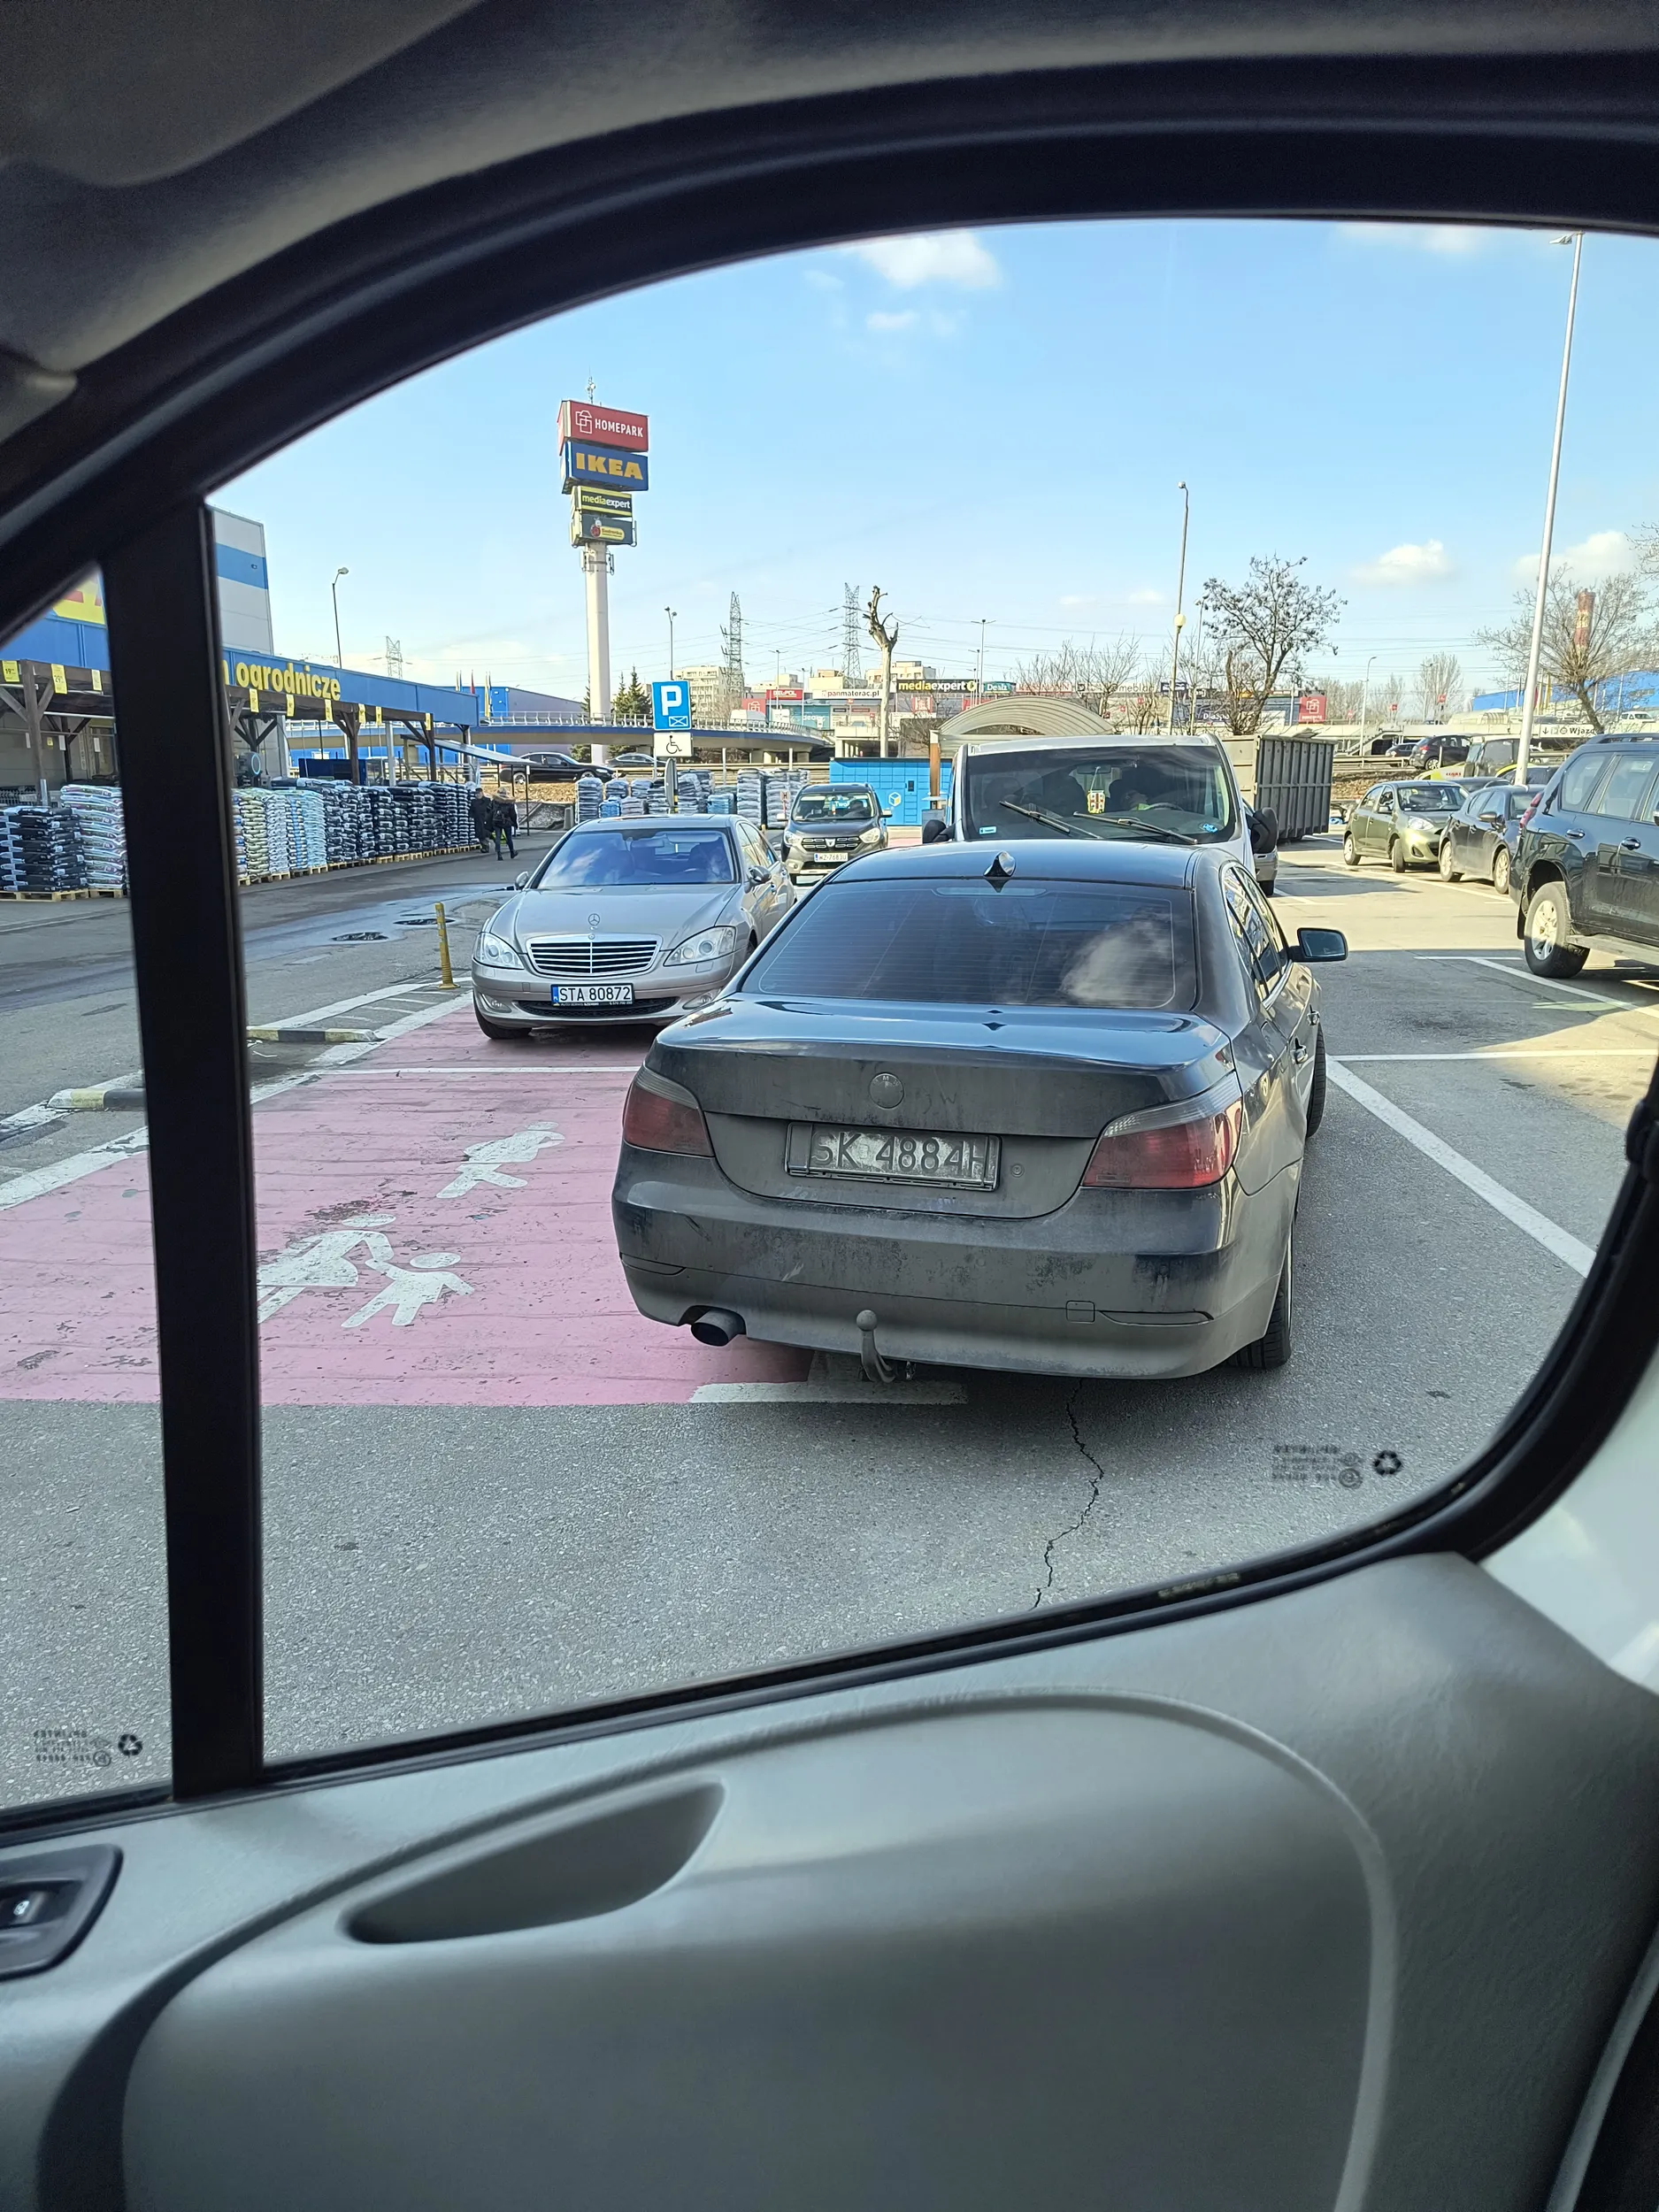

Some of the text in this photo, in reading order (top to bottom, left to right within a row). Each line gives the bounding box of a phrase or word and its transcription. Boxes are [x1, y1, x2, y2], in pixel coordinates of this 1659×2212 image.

[595, 419, 644, 437] HOMEPARK
[576, 452, 643, 480] IKEA
[582, 495, 631, 509] mediaexpert
[236, 663, 341, 701] ogrodnicze
[898, 680, 966, 692] mediaexpert
[660, 685, 682, 716] P
[559, 987, 631, 1002] STA 80872
[811, 1131, 862, 1169] SK
